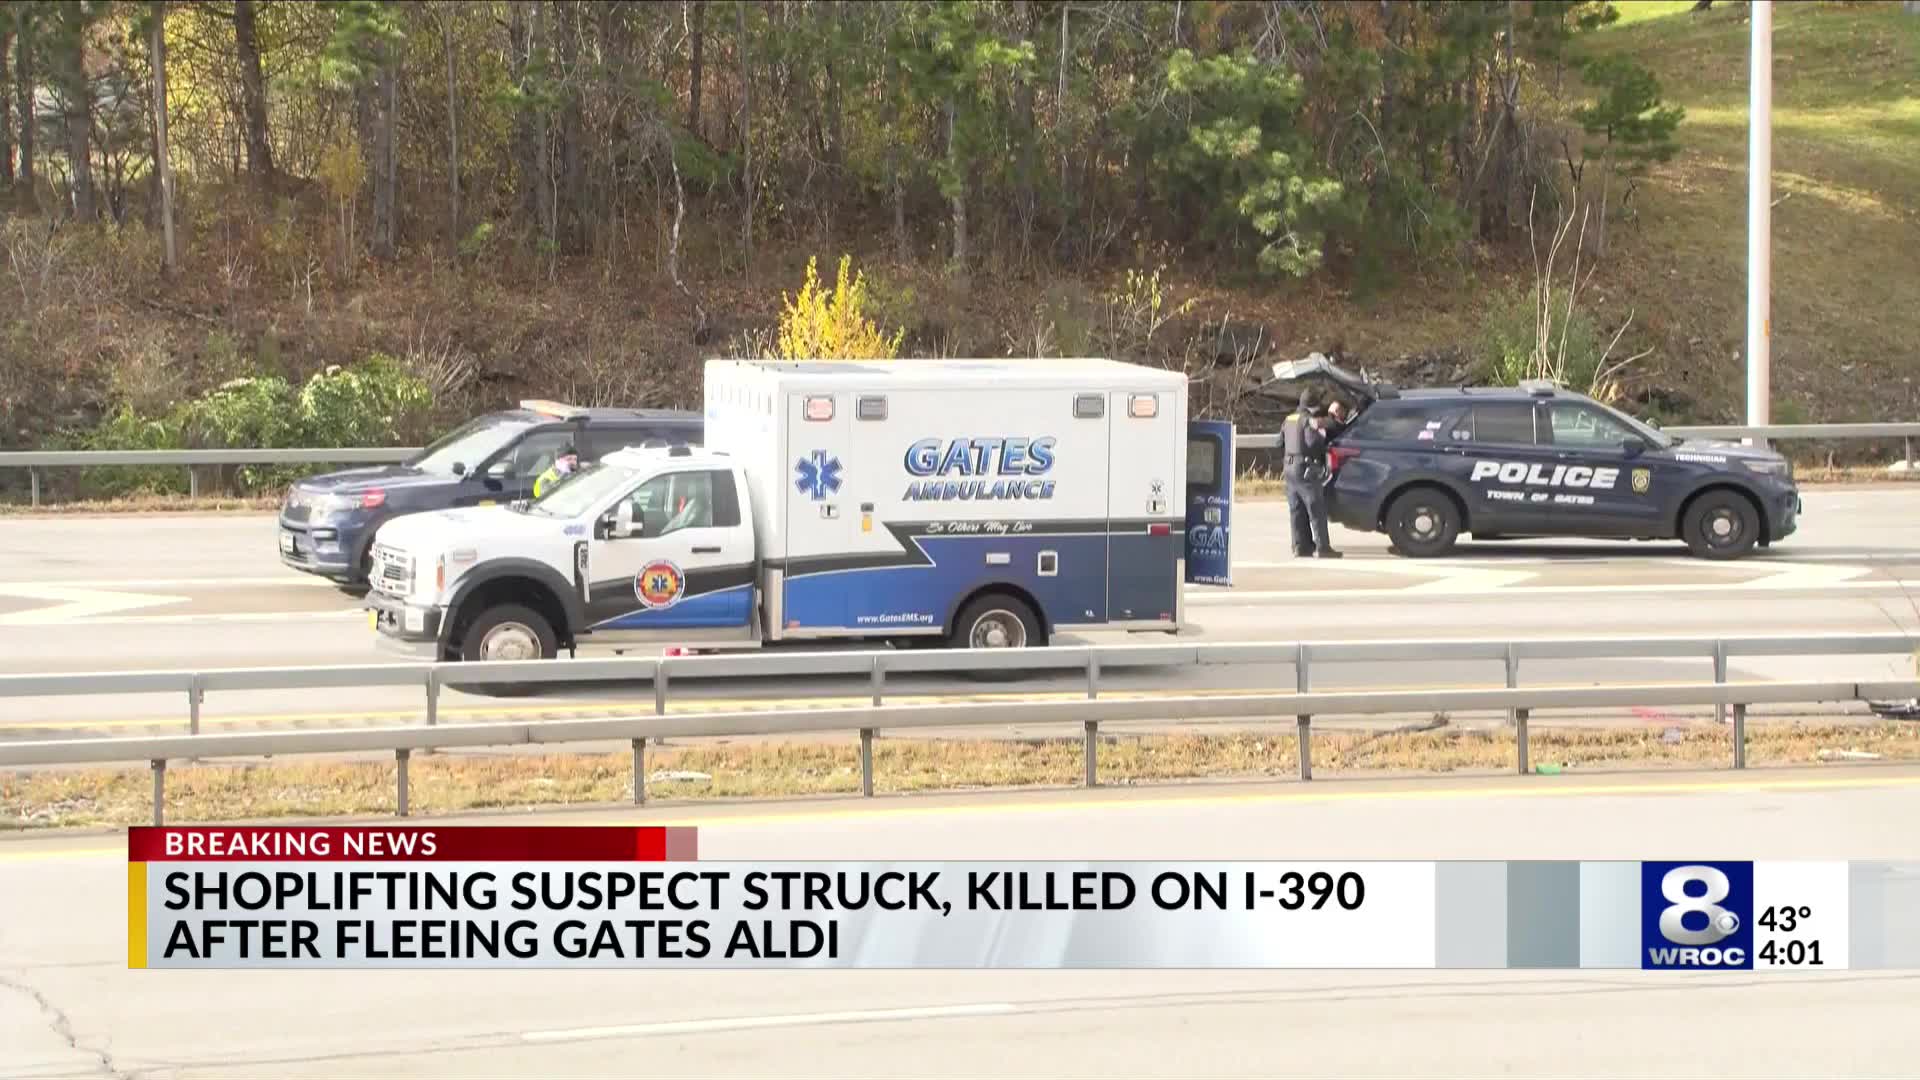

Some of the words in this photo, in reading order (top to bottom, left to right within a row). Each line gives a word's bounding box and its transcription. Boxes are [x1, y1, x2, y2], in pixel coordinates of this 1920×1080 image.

[904, 435, 1057, 477] GATES
[1675, 454, 1727, 463] TECHNICIAN
[1470, 461, 1620, 489] POLICE
[902, 480, 1056, 501] AMBULANCE
[1487, 489, 1524, 501] TOWN
[1531, 494, 1549, 502] OF
[1554, 494, 1595, 505] GATES
[926, 522, 944, 534] So
[948, 521, 980, 534] Others
[984, 521, 1009, 535] May
[1013, 520, 1033, 533] Live
[857, 612, 934, 624] www.GatesEMS.org
